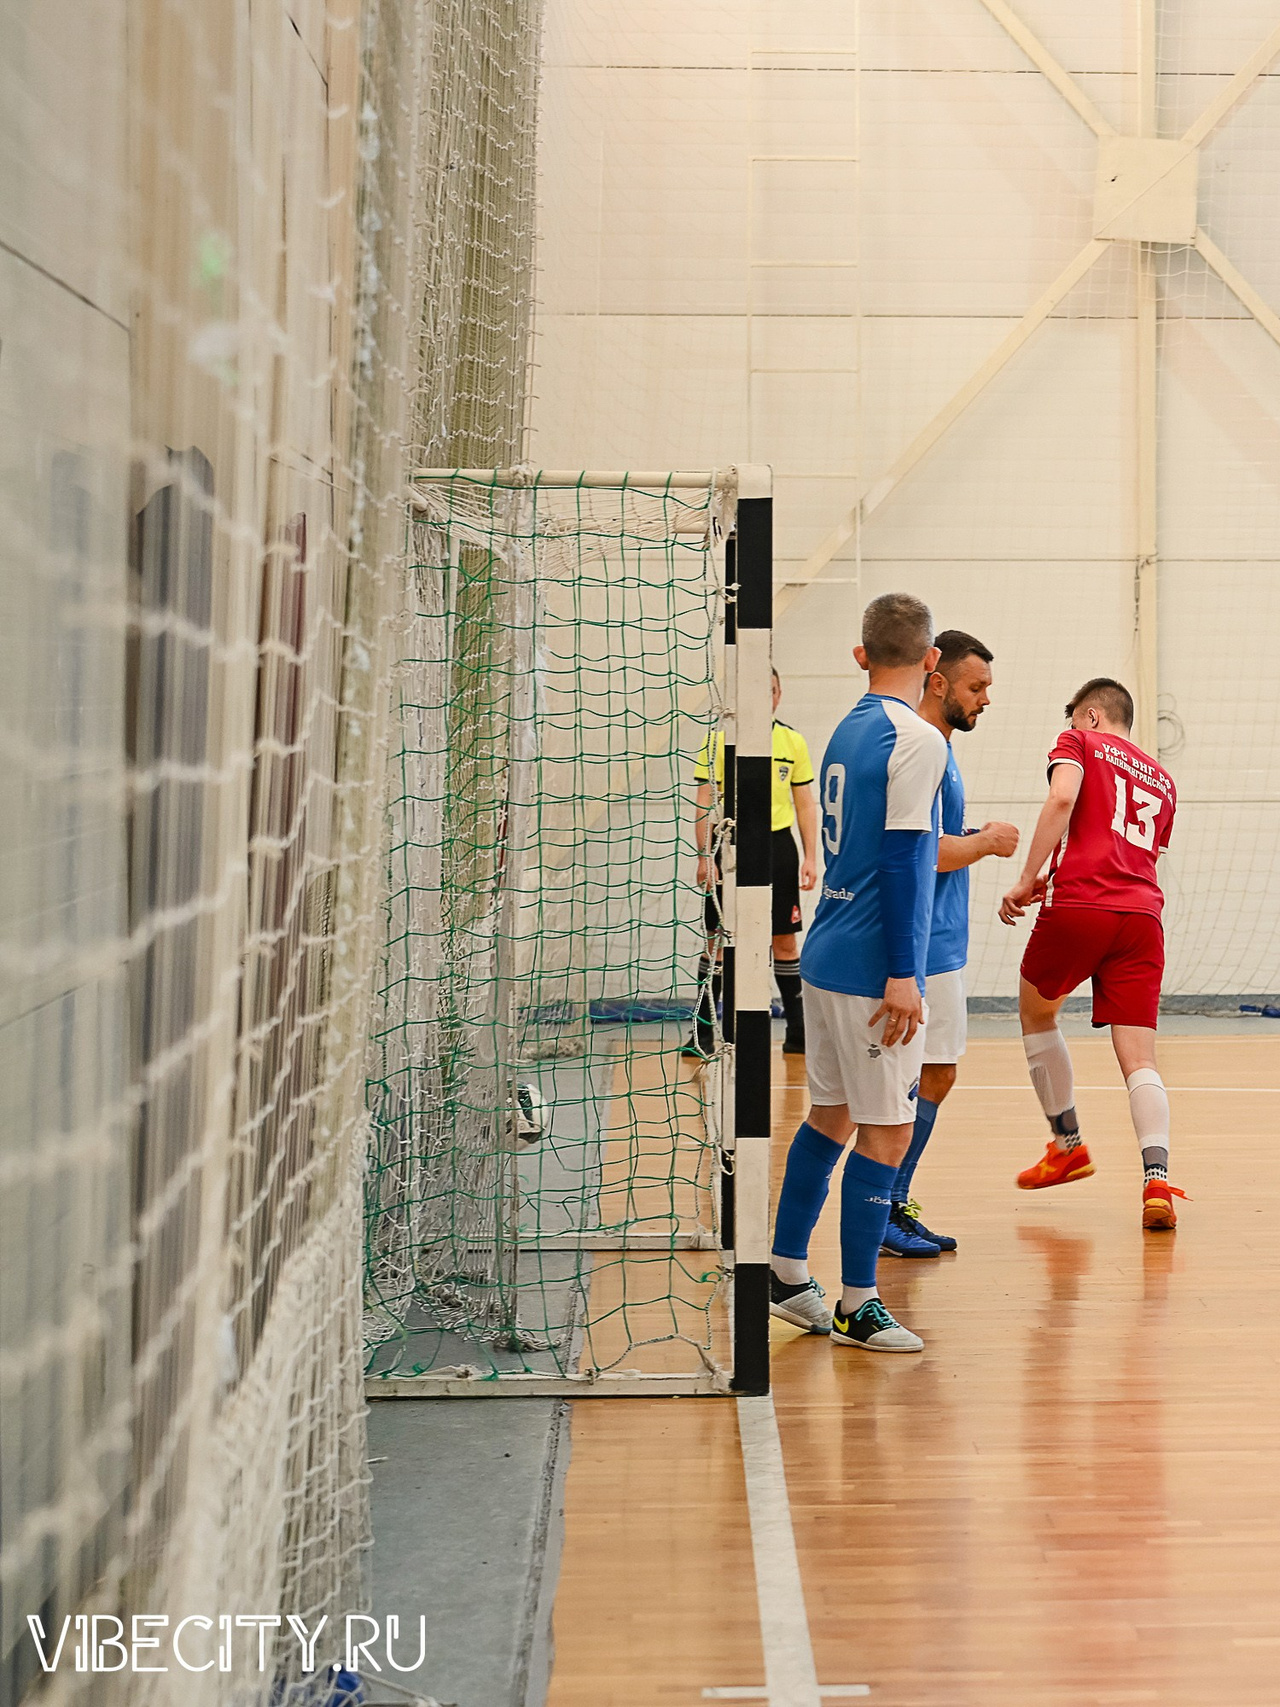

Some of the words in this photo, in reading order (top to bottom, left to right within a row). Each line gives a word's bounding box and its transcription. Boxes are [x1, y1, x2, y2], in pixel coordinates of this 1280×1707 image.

[1101, 742, 1128, 762] УФС
[1131, 757, 1155, 776] ВНГ
[1158, 771, 1172, 790] РФ
[823, 763, 846, 856] 9
[1111, 773, 1163, 852] 13
